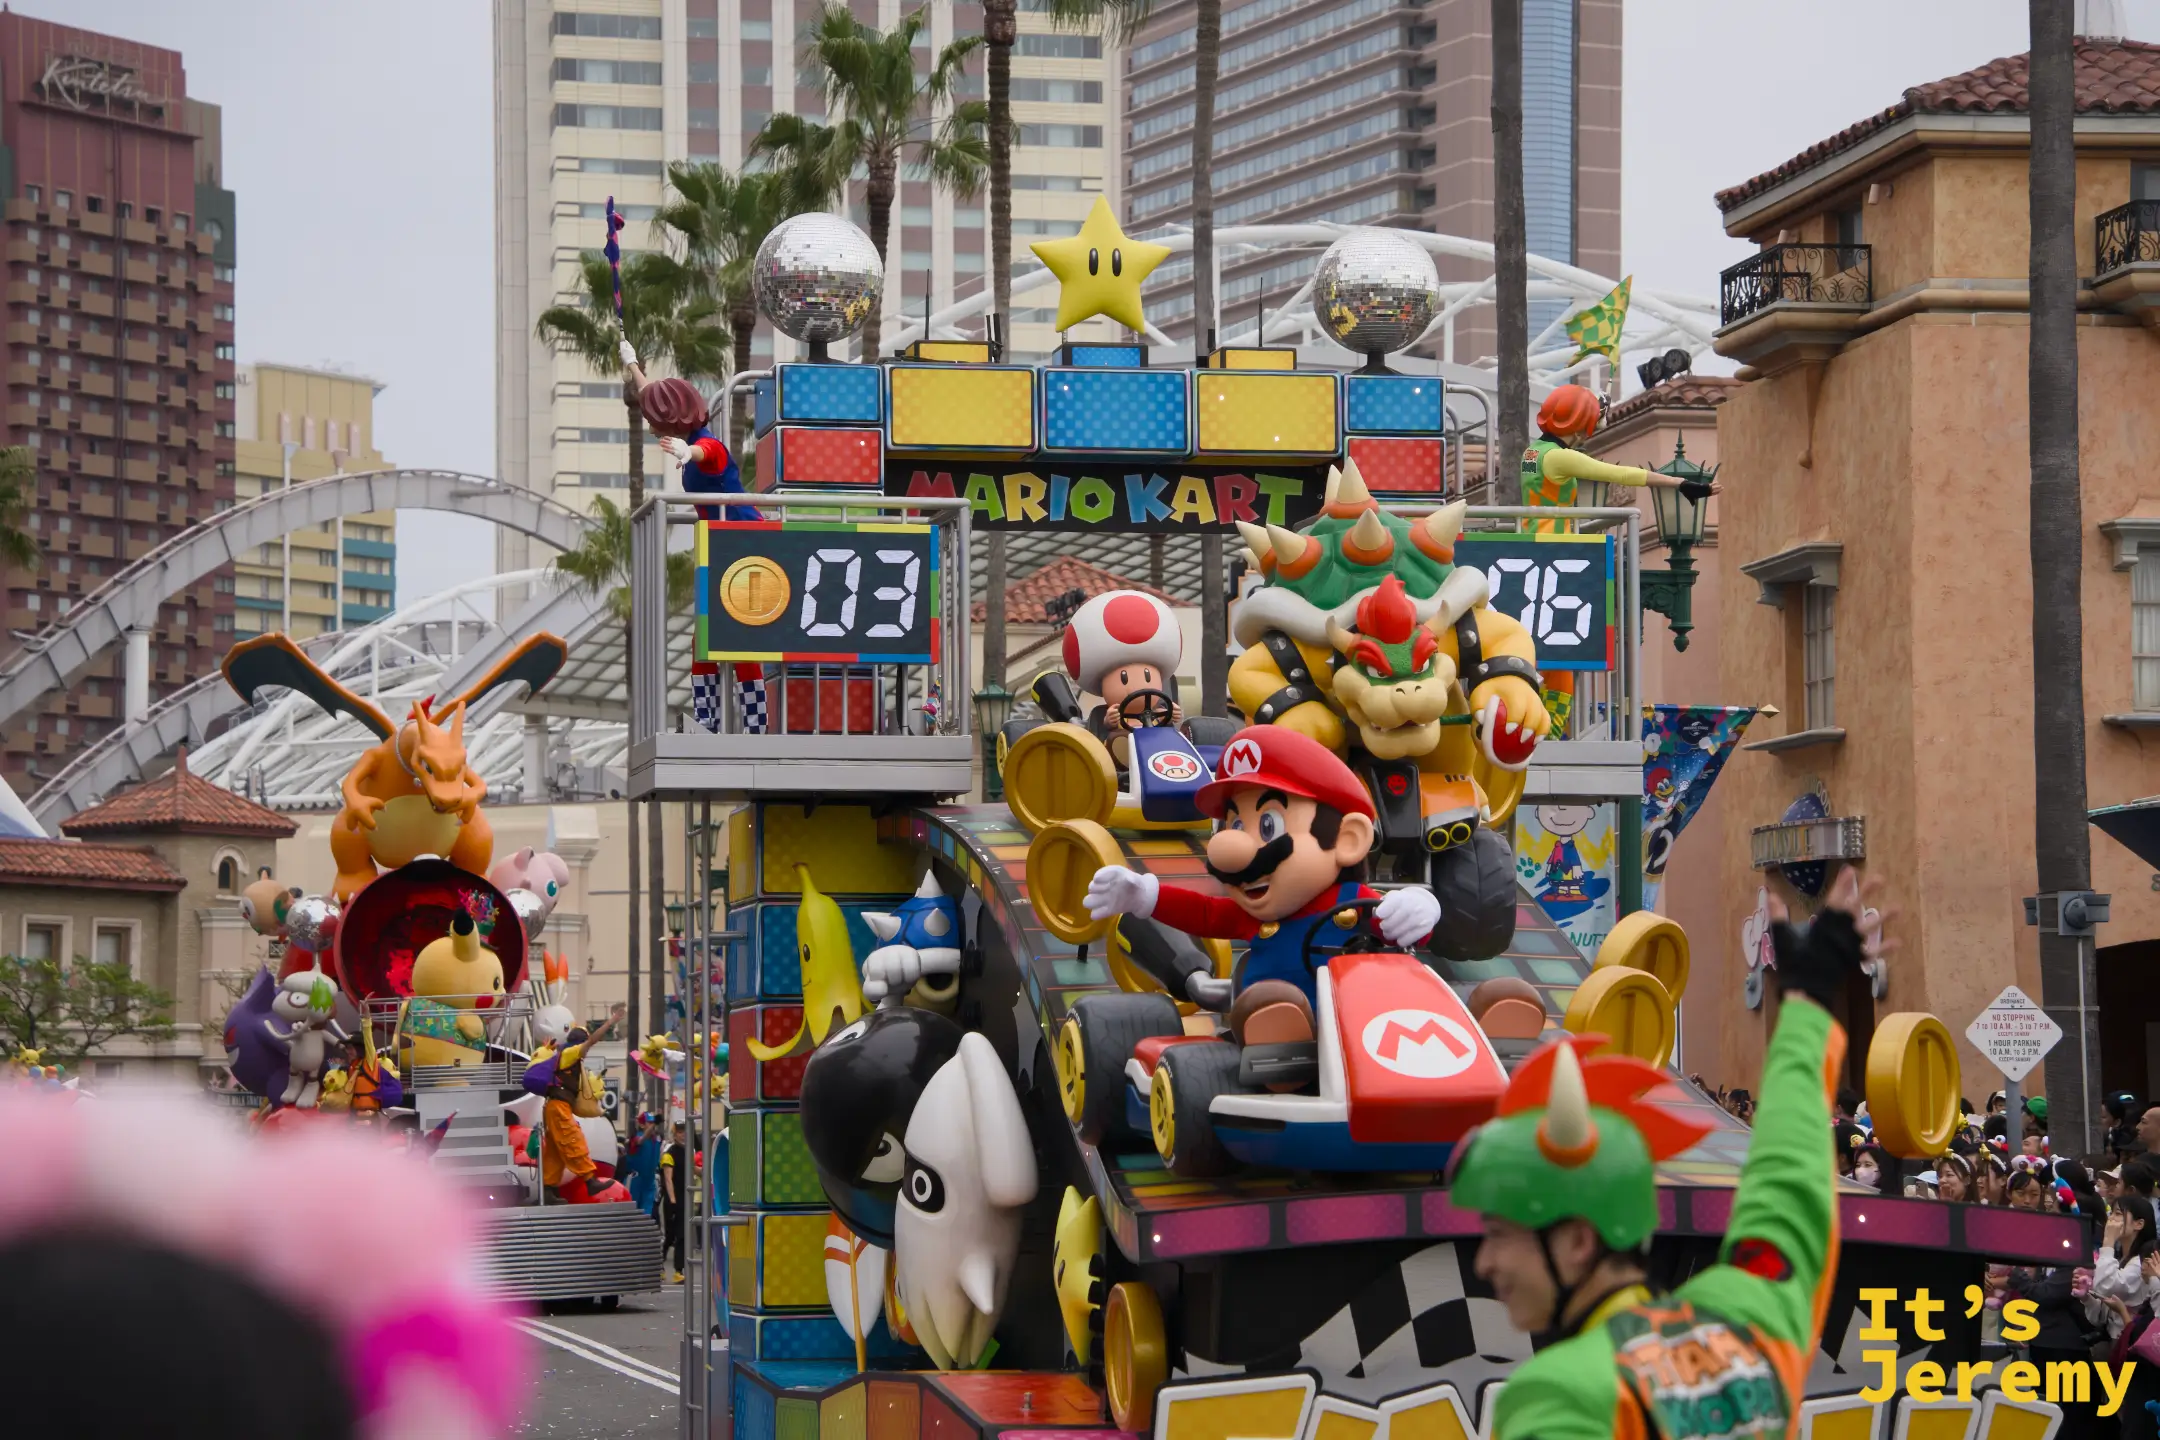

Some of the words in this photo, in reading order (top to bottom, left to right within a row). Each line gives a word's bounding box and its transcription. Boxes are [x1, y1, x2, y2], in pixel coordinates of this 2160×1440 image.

[905, 470, 1116, 523] MARIO
[1123, 472, 1304, 525] KART
[800, 548, 921, 638] 03
[1228, 746, 1258, 774] M
[1376, 1018, 1472, 1062] M
[1990, 1022, 1998, 1030] 10
[1989, 1048, 1997, 1056] 10
